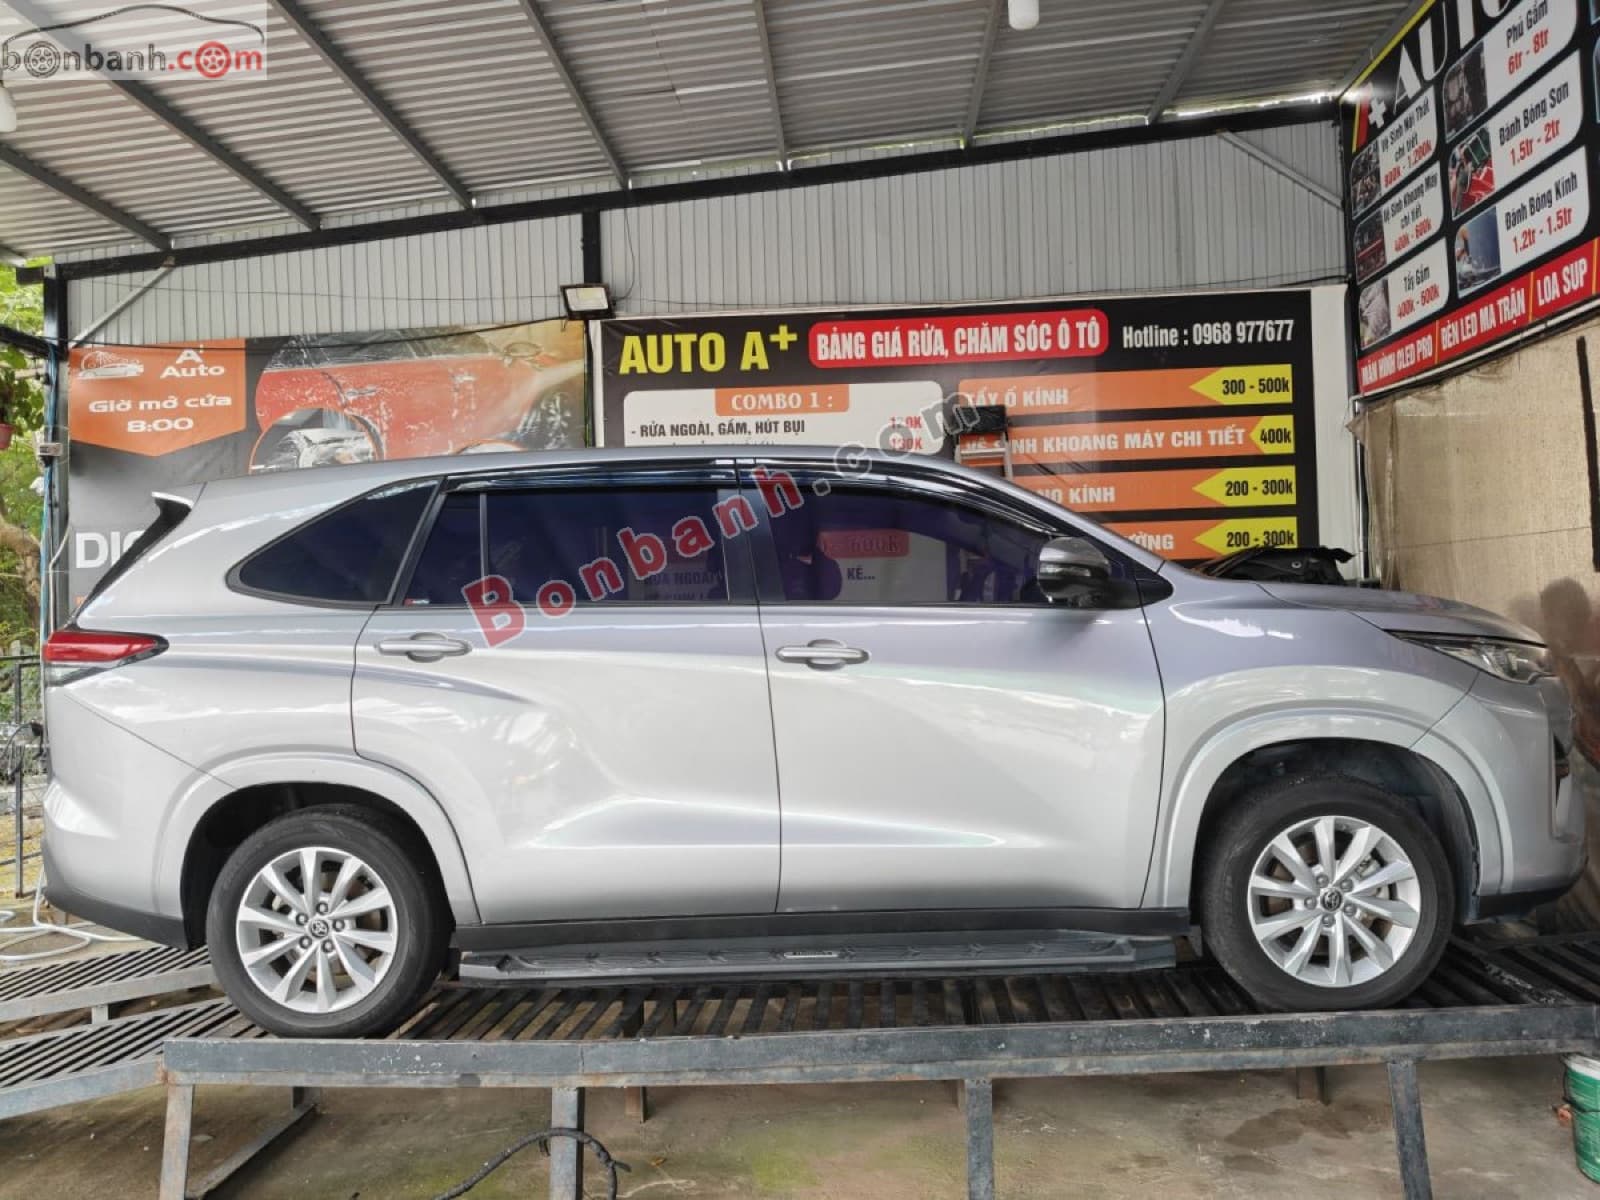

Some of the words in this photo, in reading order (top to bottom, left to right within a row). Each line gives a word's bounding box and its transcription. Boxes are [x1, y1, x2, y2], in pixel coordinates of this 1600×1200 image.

[1508, 51, 1522, 75] 6tr
[1533, 28, 1549, 54] 8tr
[1510, 136, 1534, 167] 1.5tr
[1543, 118, 1561, 145] 2tr
[1513, 227, 1536, 256] 1.2tr
[1546, 207, 1573, 236] 1.5tr
[1537, 272, 1560, 306] LOA
[1562, 257, 1588, 295] SUP
[1461, 312, 1478, 342] LED
[1479, 303, 1496, 333] MA
[1497, 287, 1526, 325] TRẬN
[817, 326, 866, 360] BẢNG
[872, 326, 903, 359] GIÁ
[908, 323, 949, 359] RỬA,
[954, 322, 1008, 355] CHĂM
[1014, 320, 1052, 352] SÓC
[1058, 317, 1070, 350] Ô
[1076, 316, 1100, 349] TÔ
[1122, 325, 1179, 348] Hotline
[1193, 321, 1232, 345] 0968
[1236, 319, 1294, 343] 977677
[619, 332, 726, 374] AUTO
[740, 324, 798, 371] A+
[1416, 334, 1433, 362] PRO
[160, 364, 225, 379] Auto
[1222, 379, 1246, 395] 300
[1258, 377, 1290, 393] 500k
[89, 400, 132, 412] Giờ
[139, 395, 178, 410] mở
[185, 394, 233, 407] cửa
[731, 392, 801, 411] COMBO
[809, 391, 820, 409] 1
[1023, 387, 1069, 407] KÍNH
[127, 418, 194, 432] 8:00
[640, 421, 666, 437] RỬA
[755, 417, 779, 433] HÚT
[783, 420, 805, 436] BỤI
[1043, 432, 1118, 453] KHOANG
[1124, 430, 1164, 449] MÁY
[1171, 430, 1201, 446] CHI
[1208, 424, 1245, 445] TIẾT
[1260, 428, 1291, 444] 400k
[1069, 485, 1115, 503] KÍNH
[1225, 481, 1249, 496] 200
[1262, 479, 1293, 495] 300k
[1226, 531, 1250, 547] 200
